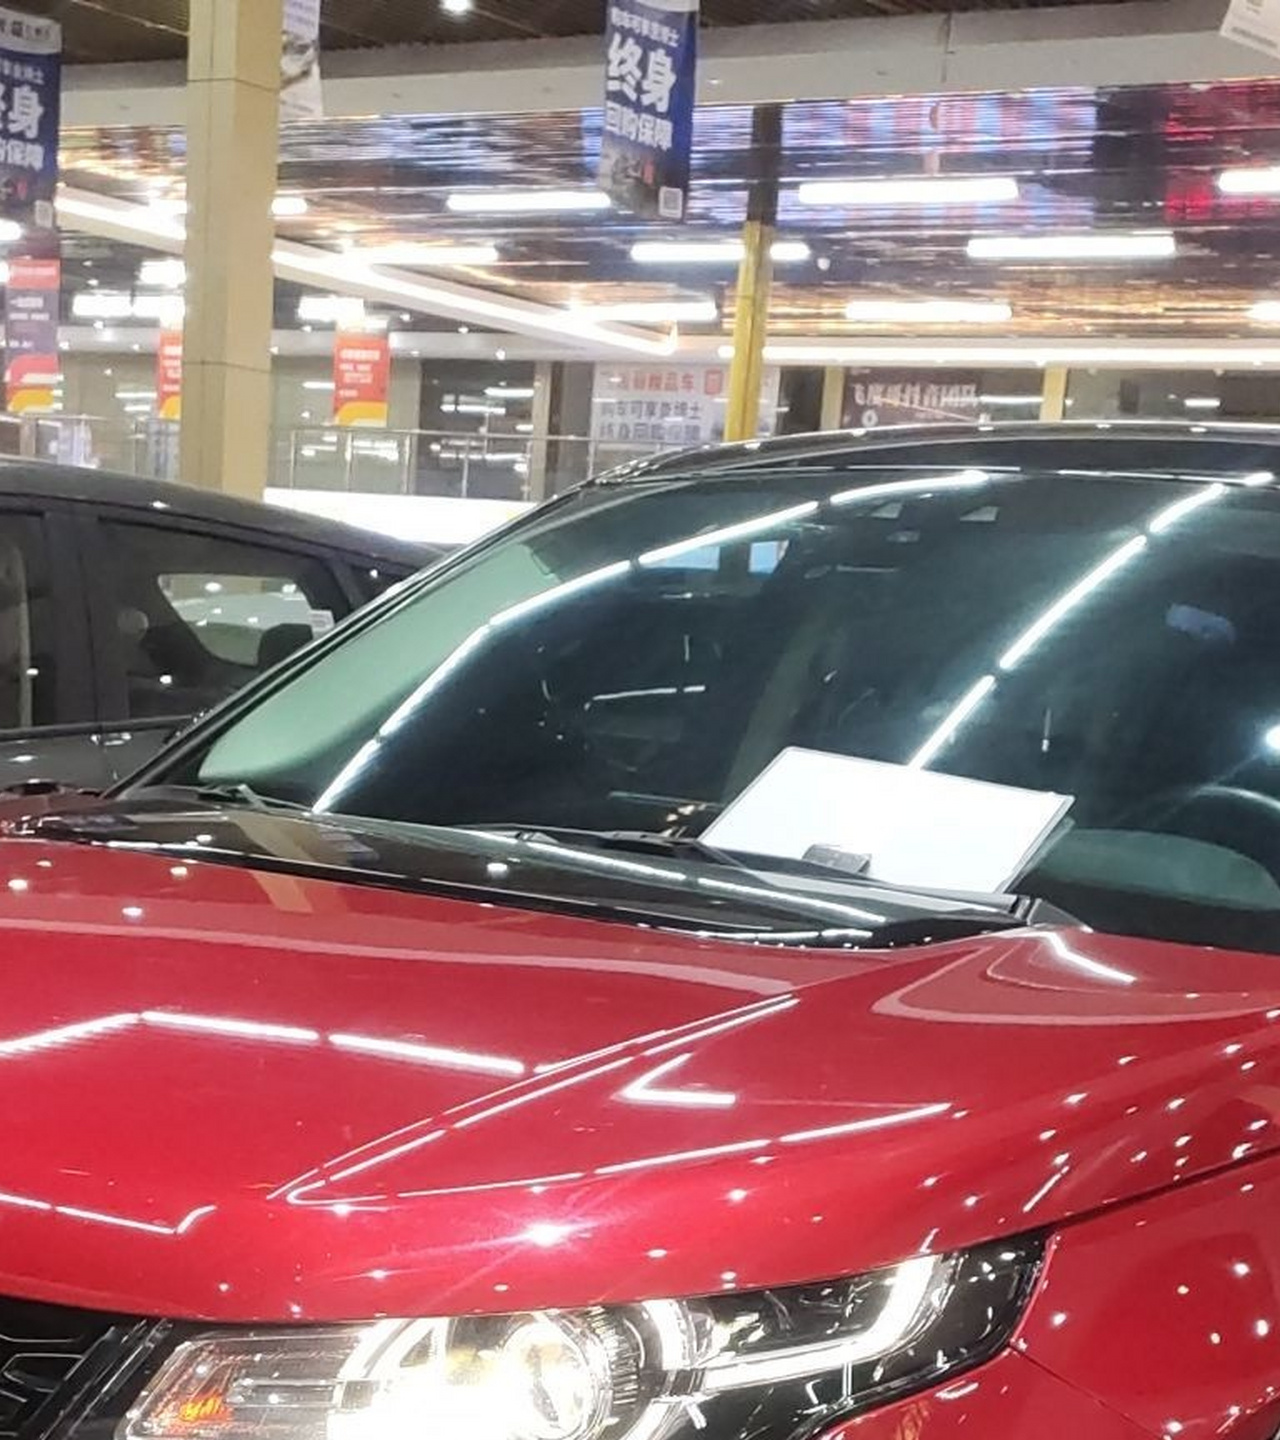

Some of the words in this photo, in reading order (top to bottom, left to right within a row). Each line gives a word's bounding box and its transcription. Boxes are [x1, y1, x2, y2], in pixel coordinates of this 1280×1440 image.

[607, 32, 676, 112] 终身
[605, 100, 673, 151] 回购保障
